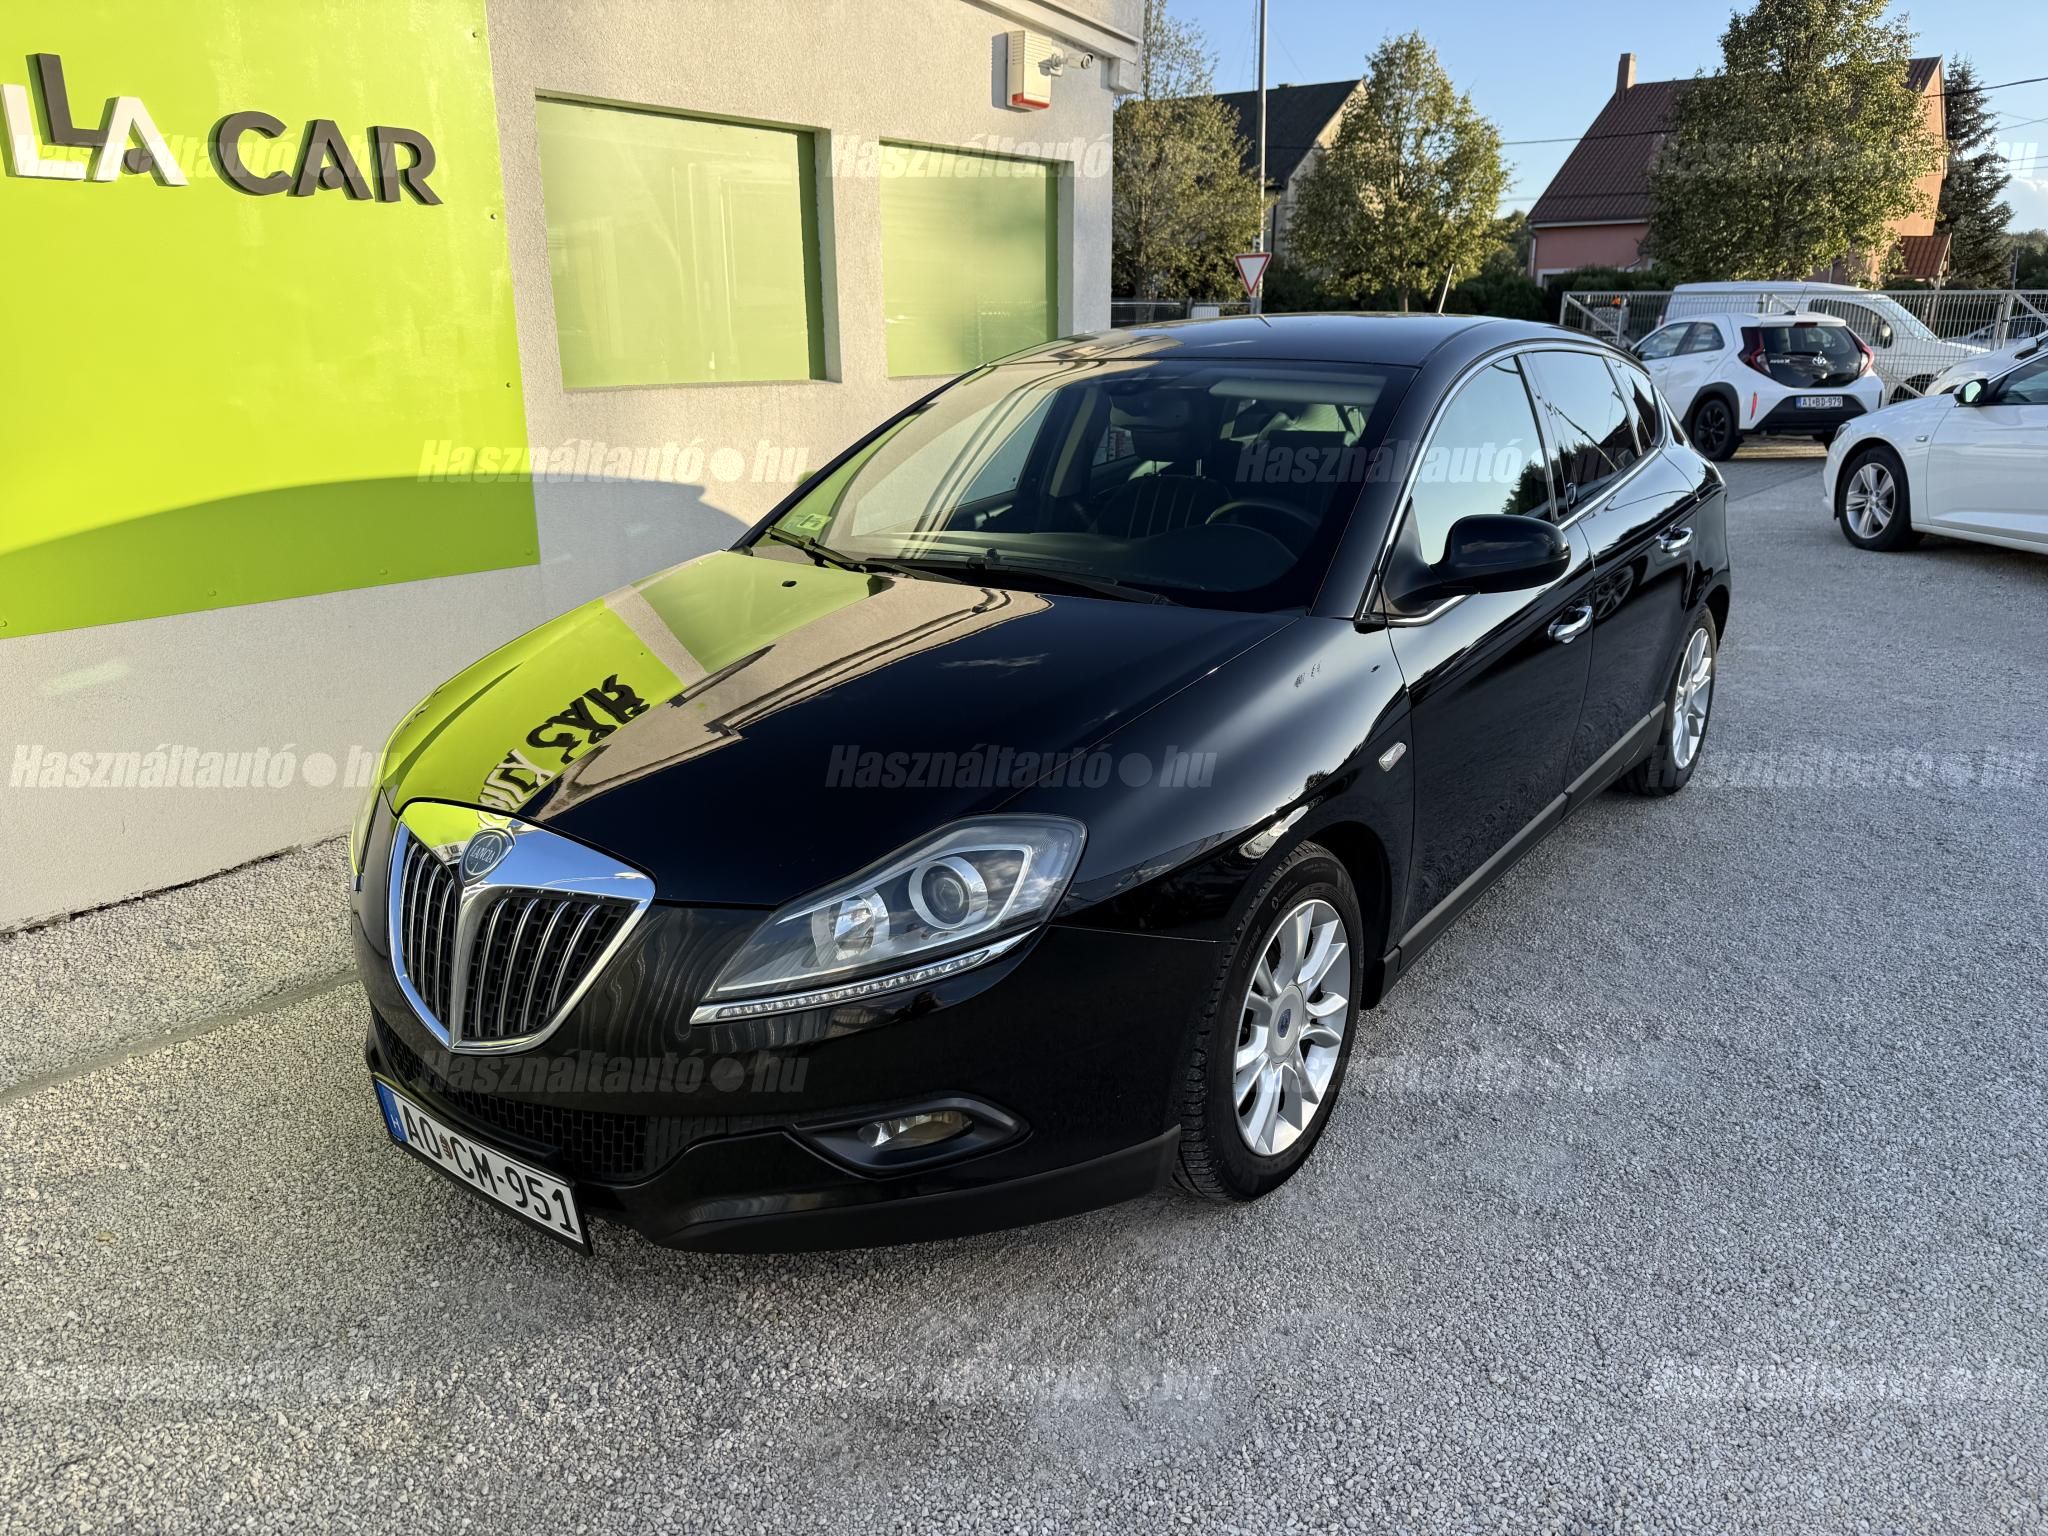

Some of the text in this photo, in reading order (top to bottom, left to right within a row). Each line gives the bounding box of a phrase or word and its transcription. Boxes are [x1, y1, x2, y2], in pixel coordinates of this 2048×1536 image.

[212, 111, 442, 205] CAR
[470, 845, 496, 864] LANCIA
[391, 1116, 402, 1132] H
